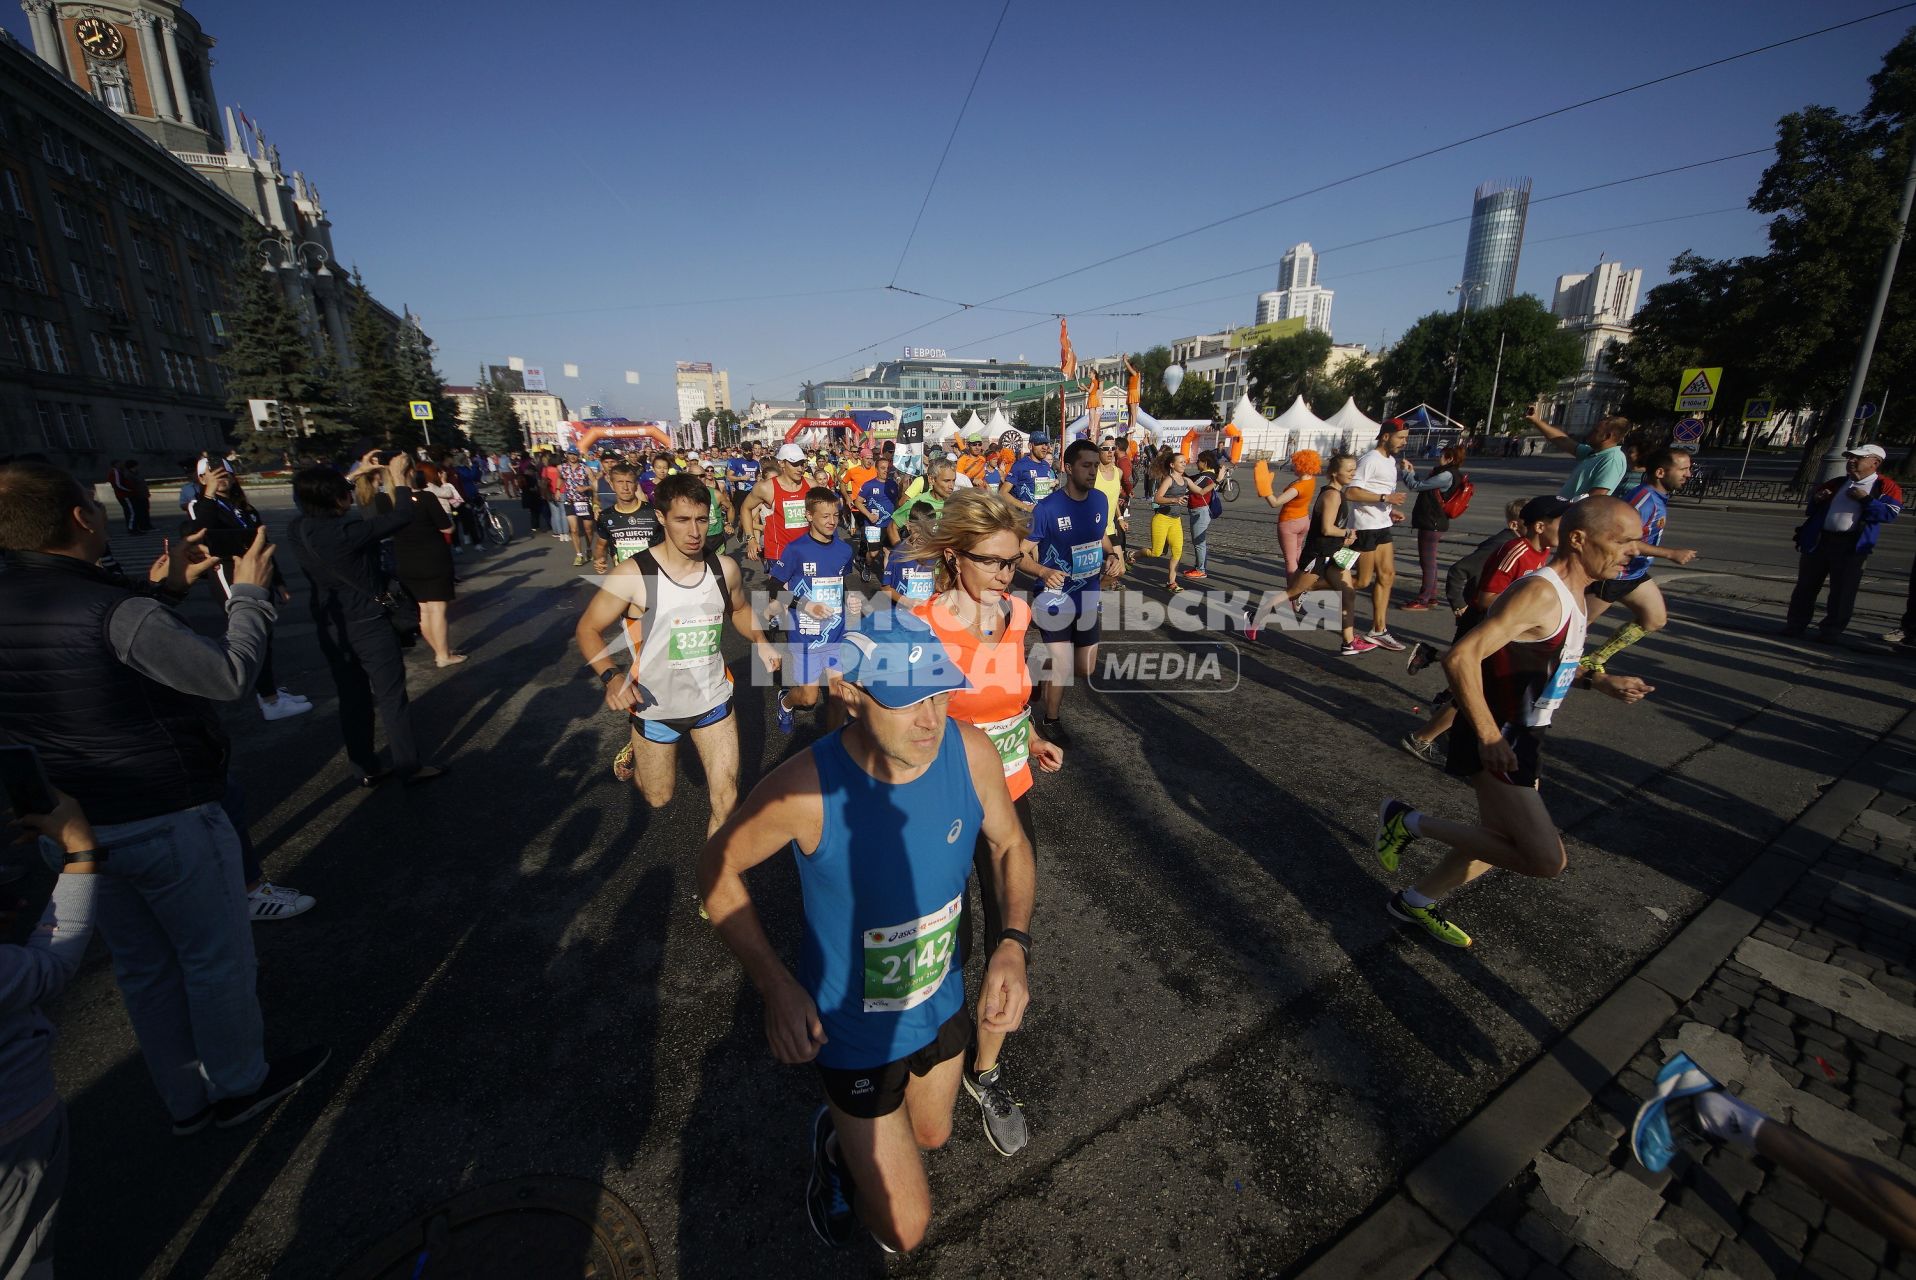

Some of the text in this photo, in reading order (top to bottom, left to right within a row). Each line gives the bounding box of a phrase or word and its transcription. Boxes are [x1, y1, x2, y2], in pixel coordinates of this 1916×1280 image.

[914, 347, 947, 358] ЕВРОПА
[1075, 550, 1100, 568] 7297
[815, 588, 842, 601] 6554
[676, 629, 718, 650] 3322
[881, 931, 951, 985] 2142
